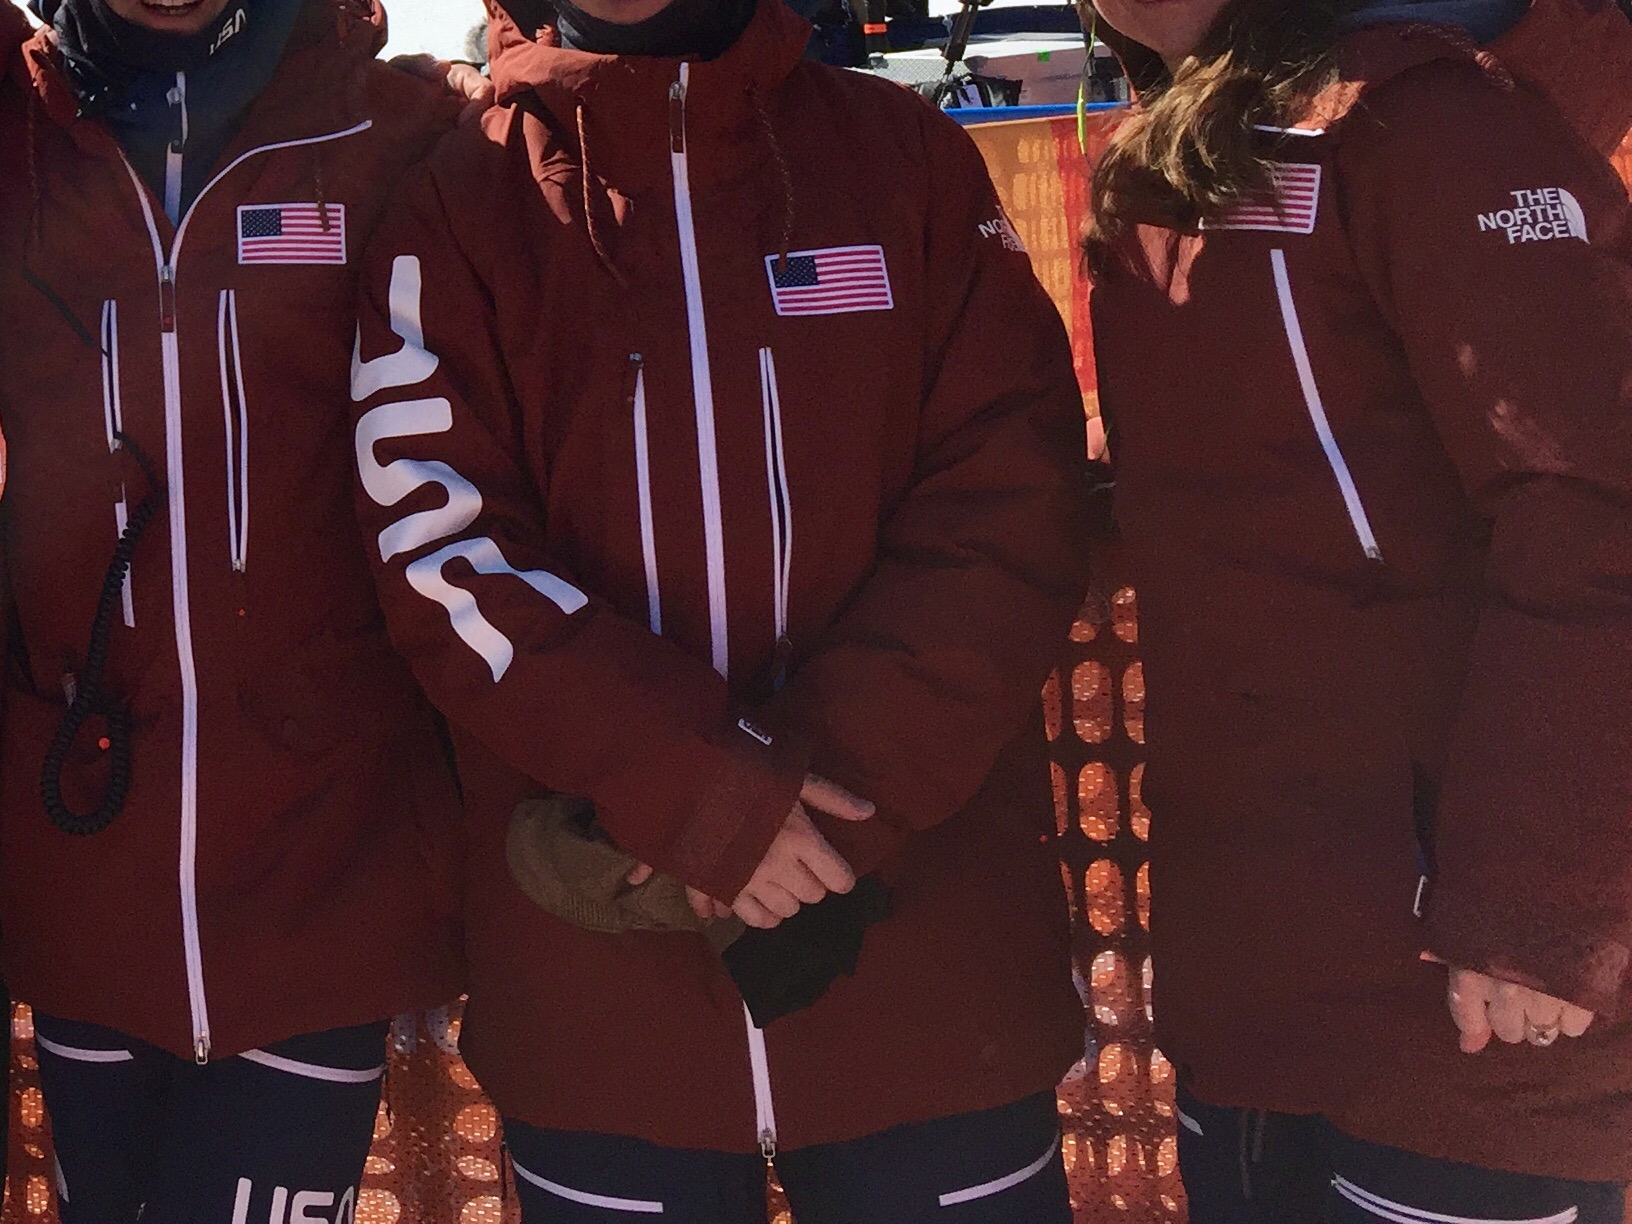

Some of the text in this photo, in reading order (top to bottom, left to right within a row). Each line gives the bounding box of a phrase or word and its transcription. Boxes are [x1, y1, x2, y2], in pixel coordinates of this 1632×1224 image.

[1510, 187, 1560, 207] THE
[1477, 204, 1565, 232] NORTH
[1507, 220, 1570, 245] FACE
